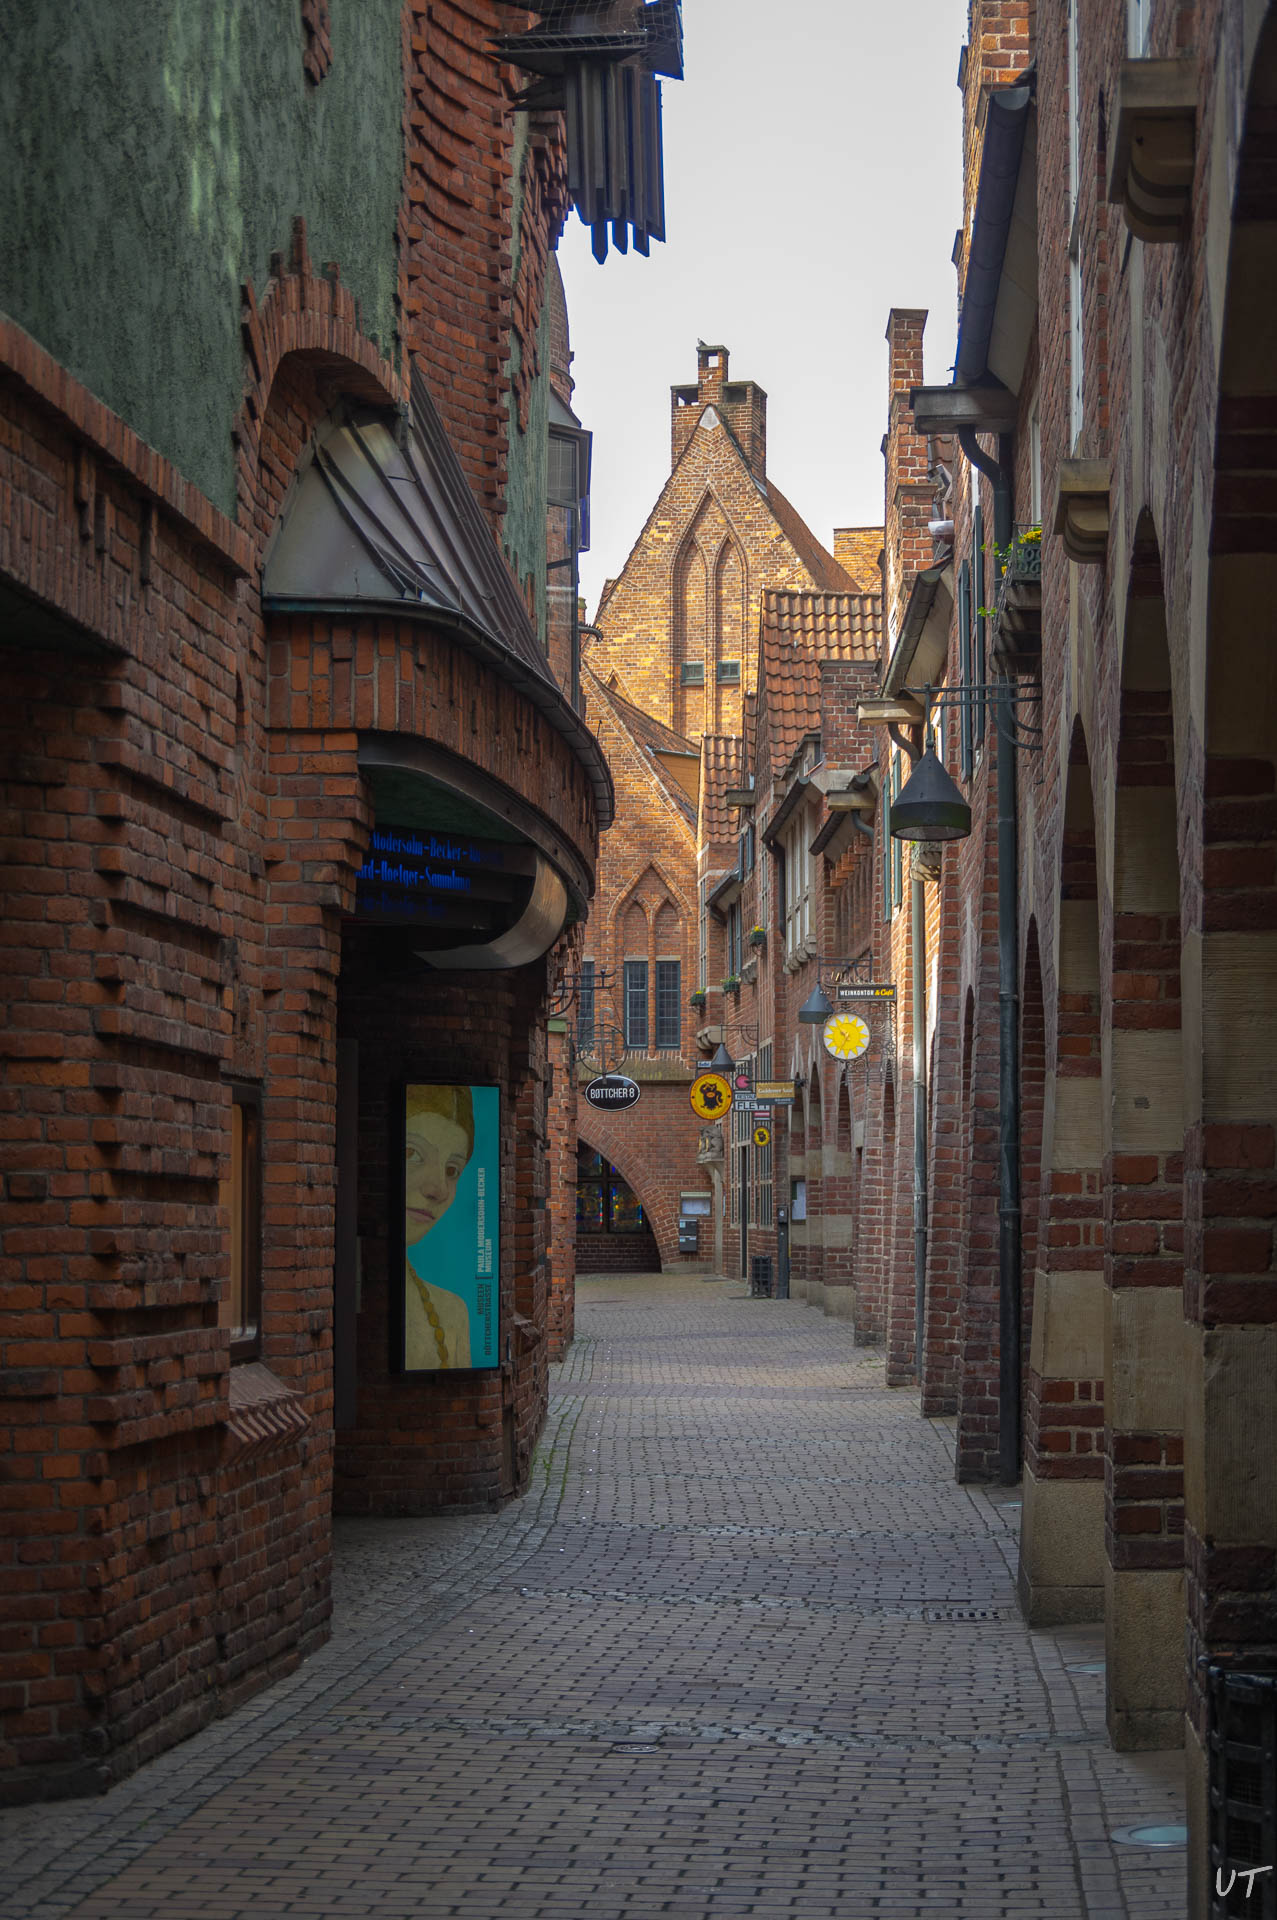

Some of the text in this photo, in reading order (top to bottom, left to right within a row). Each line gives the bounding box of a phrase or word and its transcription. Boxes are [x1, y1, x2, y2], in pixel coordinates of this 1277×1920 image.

[629, 1087, 635, 1098] 8
[477, 1167, 485, 1272] PAULA MODERSOHN-BECKER
